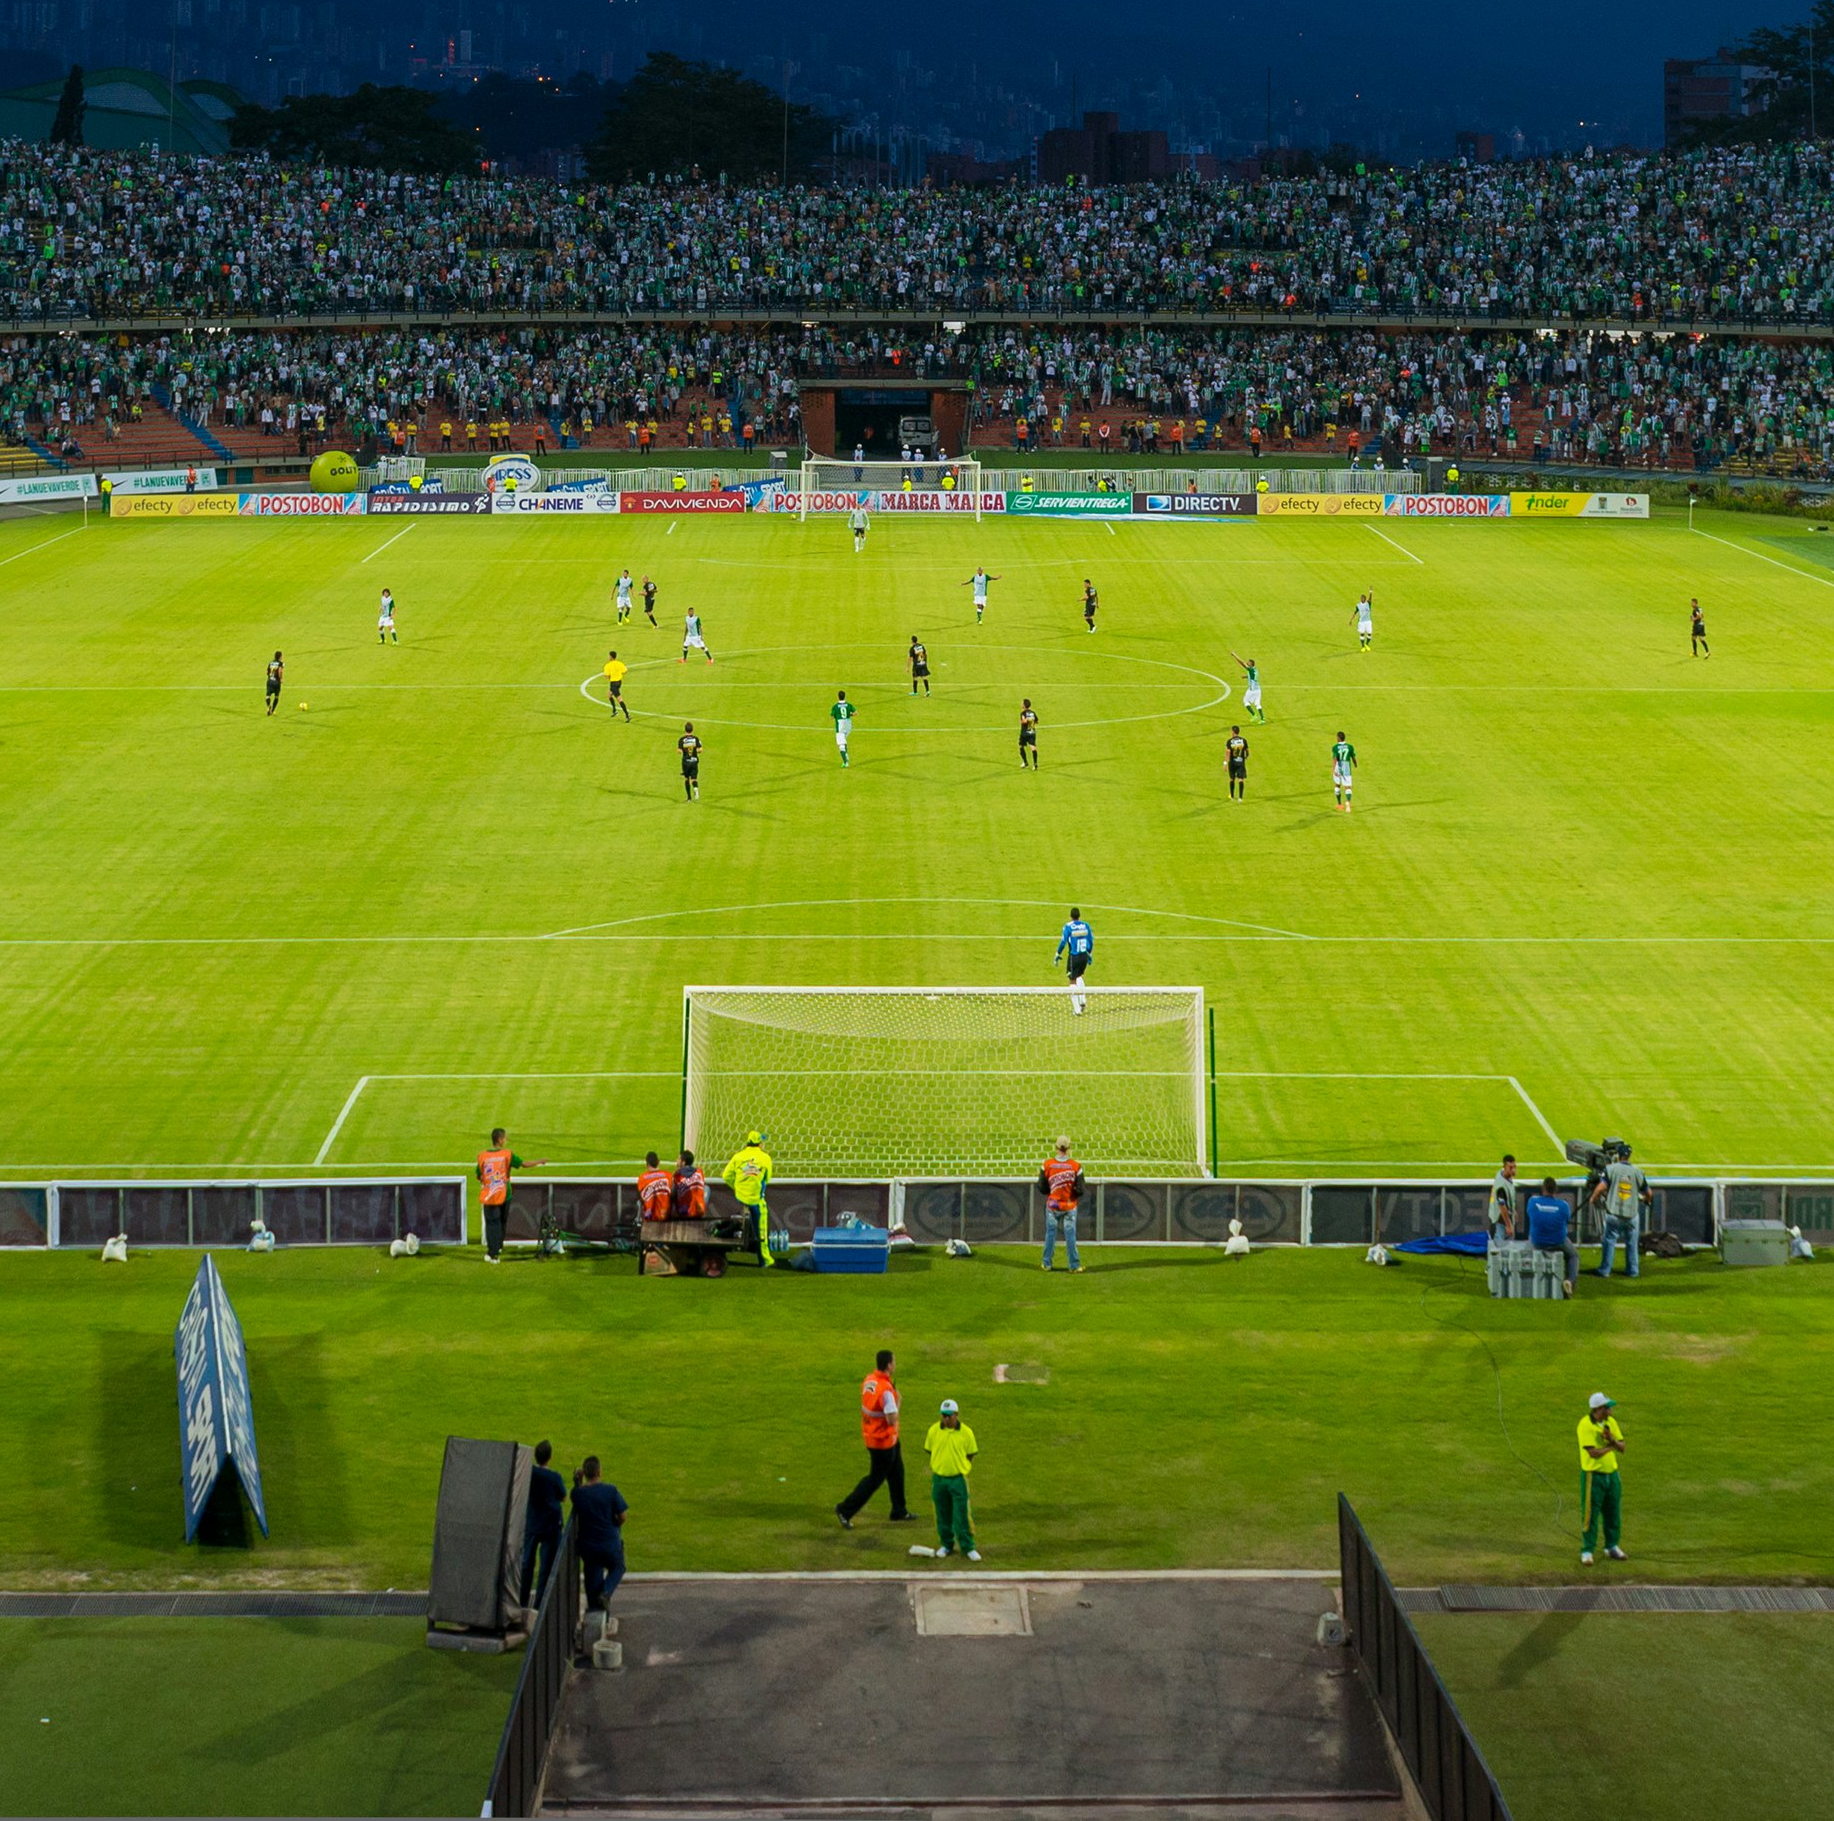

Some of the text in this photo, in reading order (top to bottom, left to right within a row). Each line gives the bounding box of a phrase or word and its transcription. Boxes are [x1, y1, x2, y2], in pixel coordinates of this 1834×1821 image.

[17, 480, 80, 495] #LANUEVAVERDE
[133, 498, 236, 514] efecty efecty
[259, 496, 343, 514] POSTOBON
[371, 501, 470, 512] RAPIDISIMO
[519, 498, 583, 511] CHANEME
[643, 498, 742, 510] DAVIVIENDA
[774, 493, 858, 511] POSTOBON
[881, 493, 1005, 511] MARCA MARCA
[1035, 497, 1128, 509] SERVIENTREGA
[1280, 497, 1382, 513] efecty efecty
[1405, 497, 1490, 515] POSTOBON
[840, 707, 847, 719] 9
[1338, 748, 1349, 760] 17
